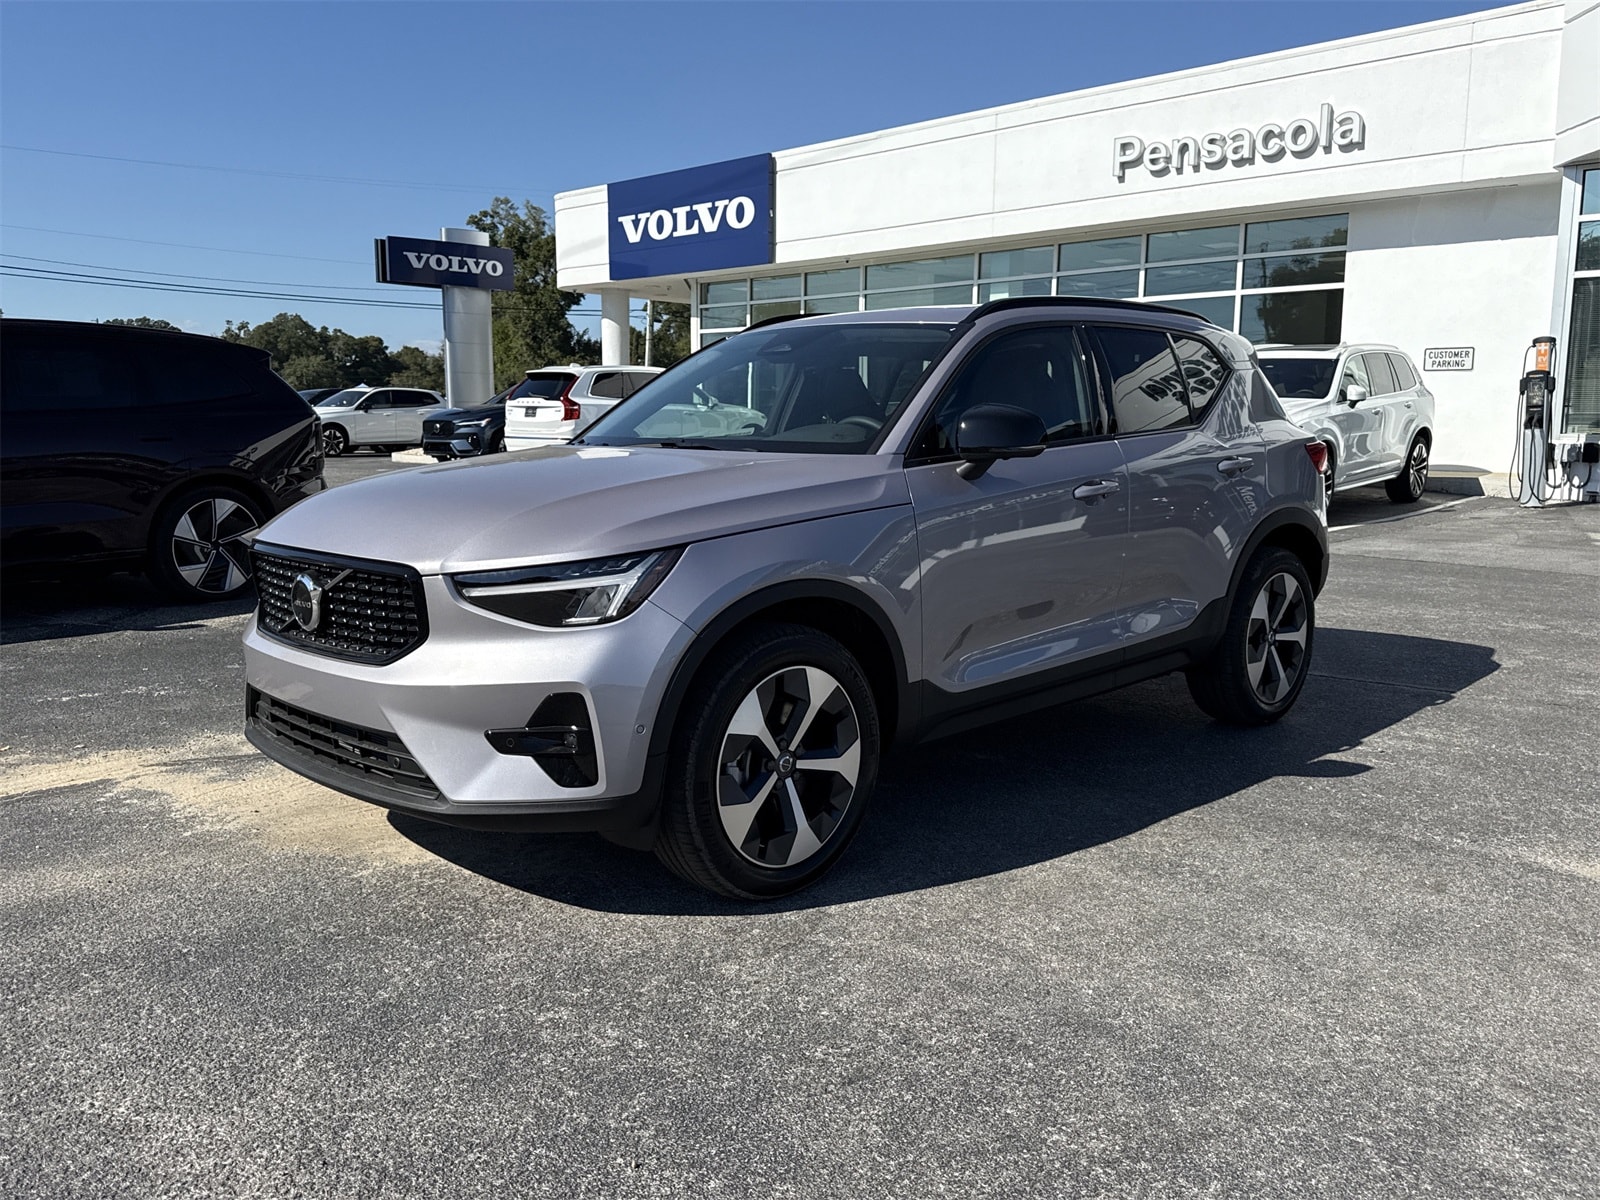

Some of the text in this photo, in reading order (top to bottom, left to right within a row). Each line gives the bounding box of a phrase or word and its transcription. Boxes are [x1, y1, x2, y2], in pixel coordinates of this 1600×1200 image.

[1112, 103, 1366, 180] Pensacola
[617, 195, 755, 244] VOLVO
[402, 250, 504, 277] VOLVO
[1428, 350, 1470, 359] CUSTOMER
[1431, 359, 1466, 368] PARKING
